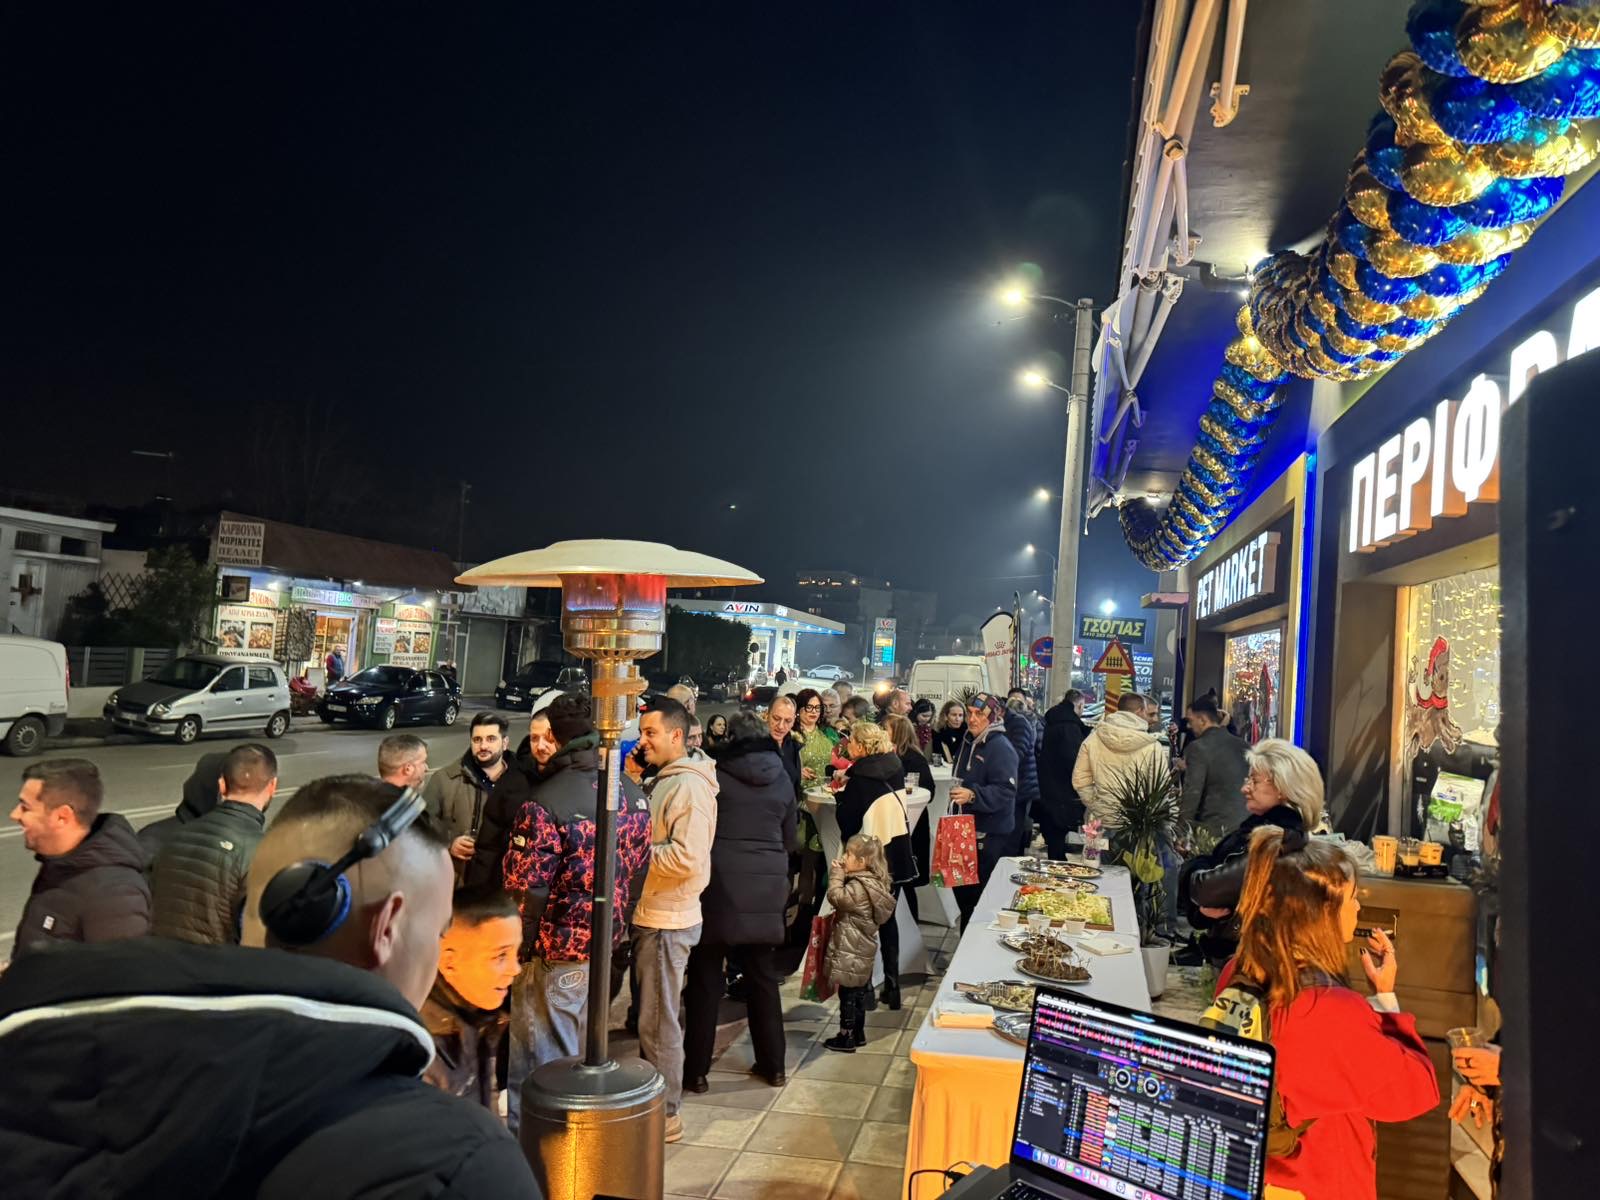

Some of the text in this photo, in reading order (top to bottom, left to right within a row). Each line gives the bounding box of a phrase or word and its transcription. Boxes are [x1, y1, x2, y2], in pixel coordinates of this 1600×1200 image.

[221, 523, 262, 537] ΚΑΡΒΟΥΝΑ
[220, 536, 261, 548] ΜΠΡΙΚΕΤΕΣ
[1196, 530, 1268, 619] PET MARKET
[725, 603, 760, 613] AVIN
[1083, 617, 1145, 637] ΤΣΟΓΙΑΣ
